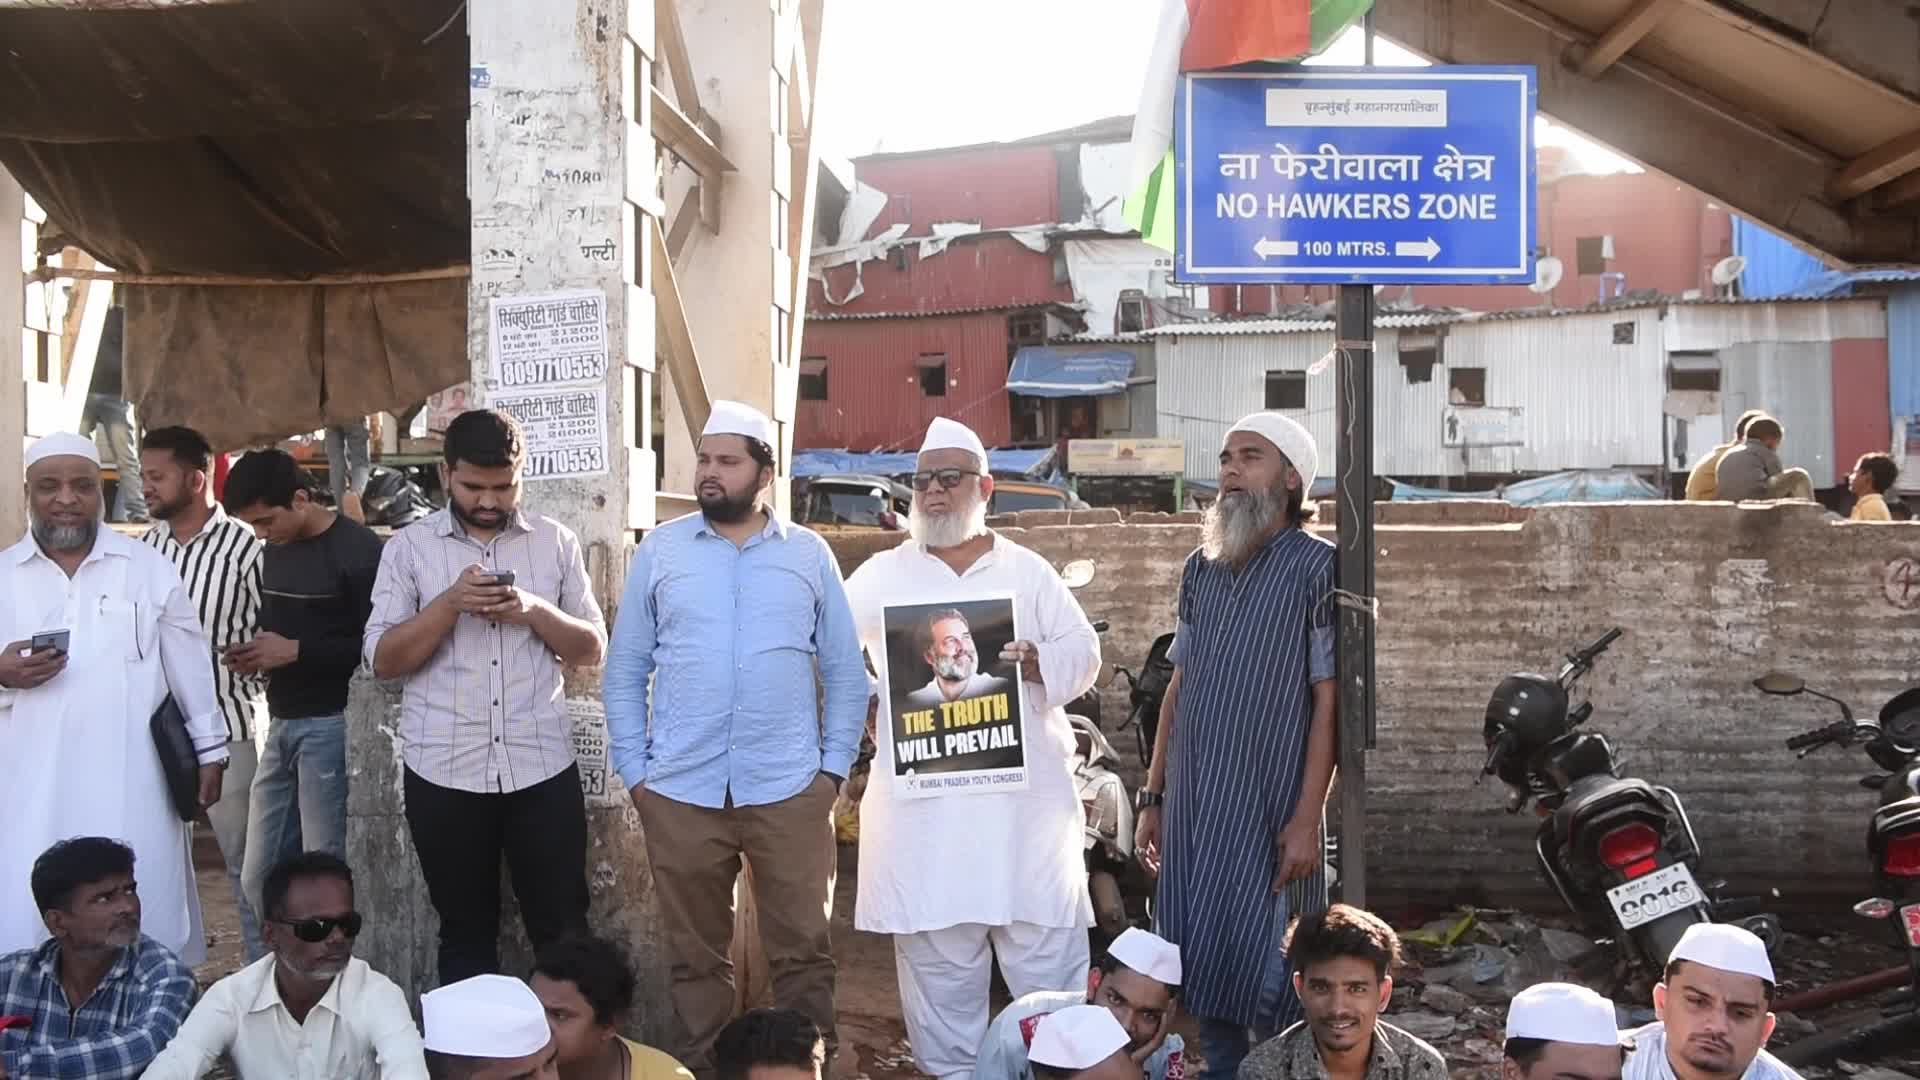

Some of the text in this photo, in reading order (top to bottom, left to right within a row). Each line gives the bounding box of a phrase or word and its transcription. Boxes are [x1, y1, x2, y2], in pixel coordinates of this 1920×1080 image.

[1354, 98, 1440, 113] महानगरपालिका
[1218, 143, 1496, 181] ना फेरीवाला क्षेत्र
[1216, 193, 1497, 220] NO HAWKERS ZONE
[1303, 241, 1391, 256] 100 MTRS.
[551, 325, 599, 336] 21200
[501, 353, 604, 385] 8097710553
[548, 418, 596, 429] 21200
[522, 447, 602, 477] 97710553
[902, 693, 1009, 735] THE TRUTH
[897, 724, 1018, 763] WILL PREVAIL
[972, 774, 992, 785] YOUTH
[992, 772, 1023, 785] CONGRESS
[1620, 880, 1696, 924] 9016
